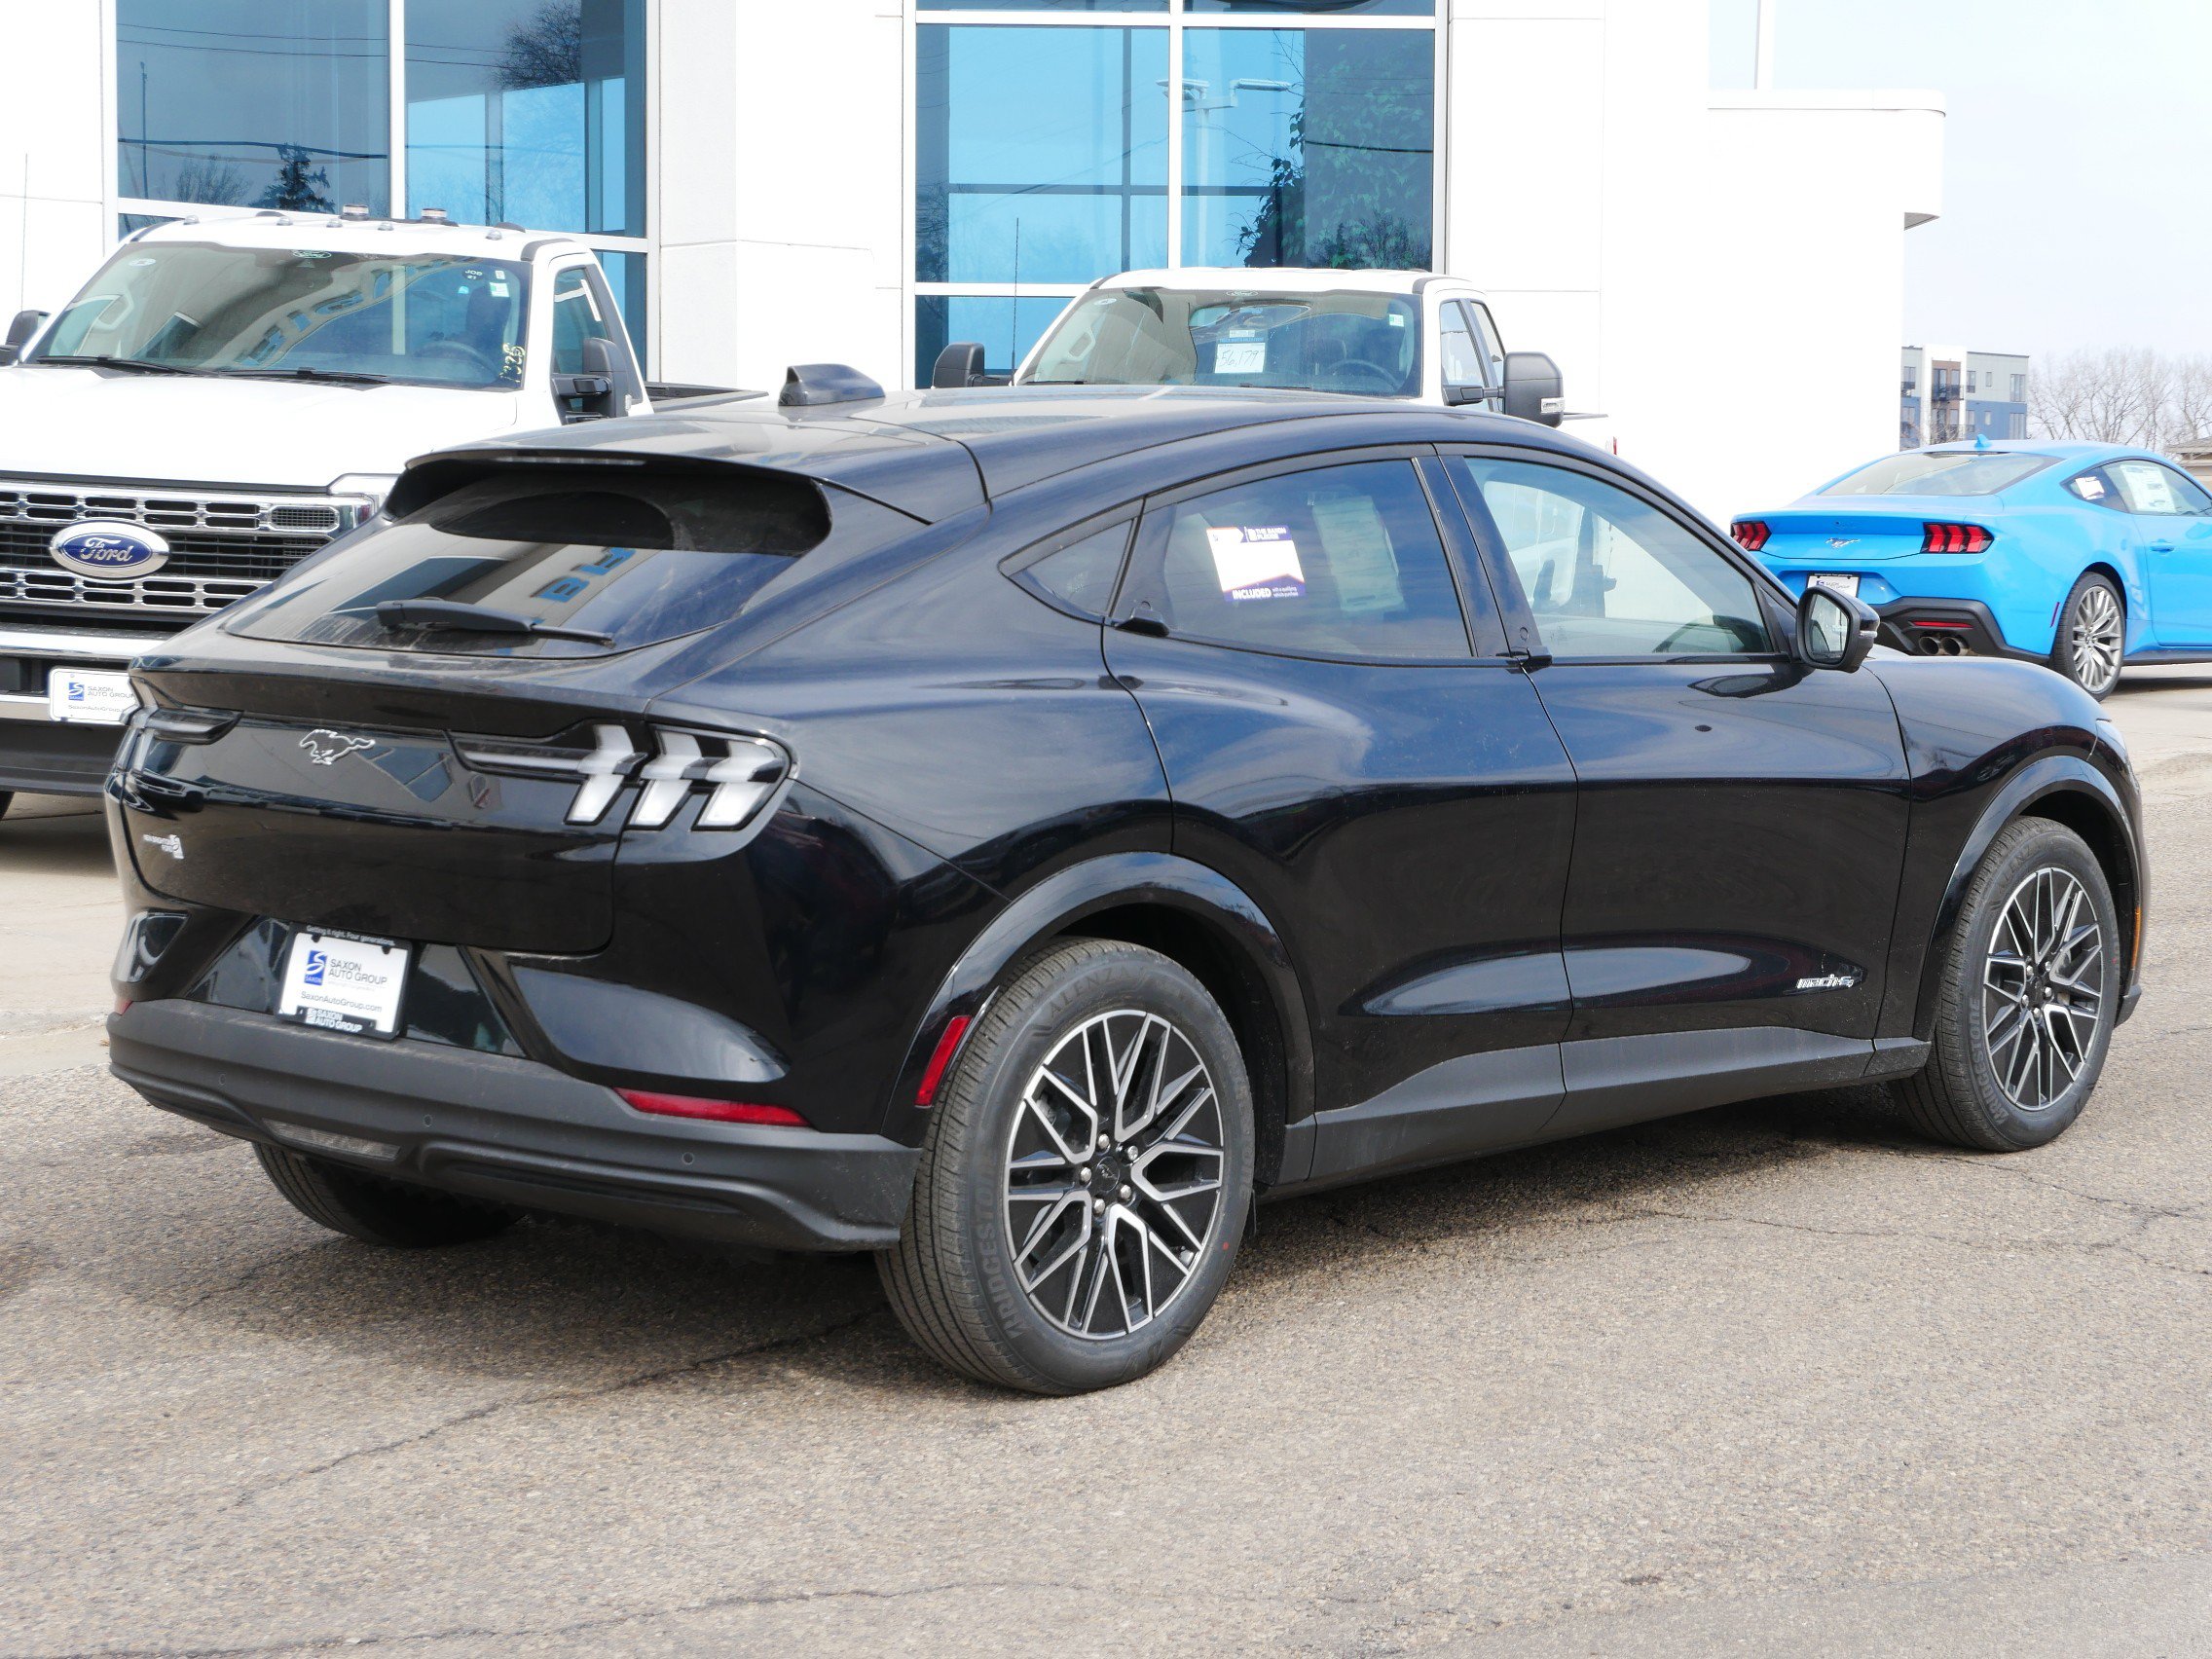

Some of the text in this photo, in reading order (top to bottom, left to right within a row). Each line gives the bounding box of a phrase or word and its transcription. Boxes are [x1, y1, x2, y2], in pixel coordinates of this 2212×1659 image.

[80, 536, 133, 562] Ford
[1233, 588, 1272, 600] INCLUDED
[330, 959, 362, 972] SAXON
[328, 969, 387, 984] AUTO GROUP
[301, 990, 383, 1013] SaxonAutoGroup.com
[317, 1009, 344, 1021] SAXON
[315, 1016, 363, 1033] AUTO GROUP
[1970, 997, 2009, 1125] BRIDGESTONE
